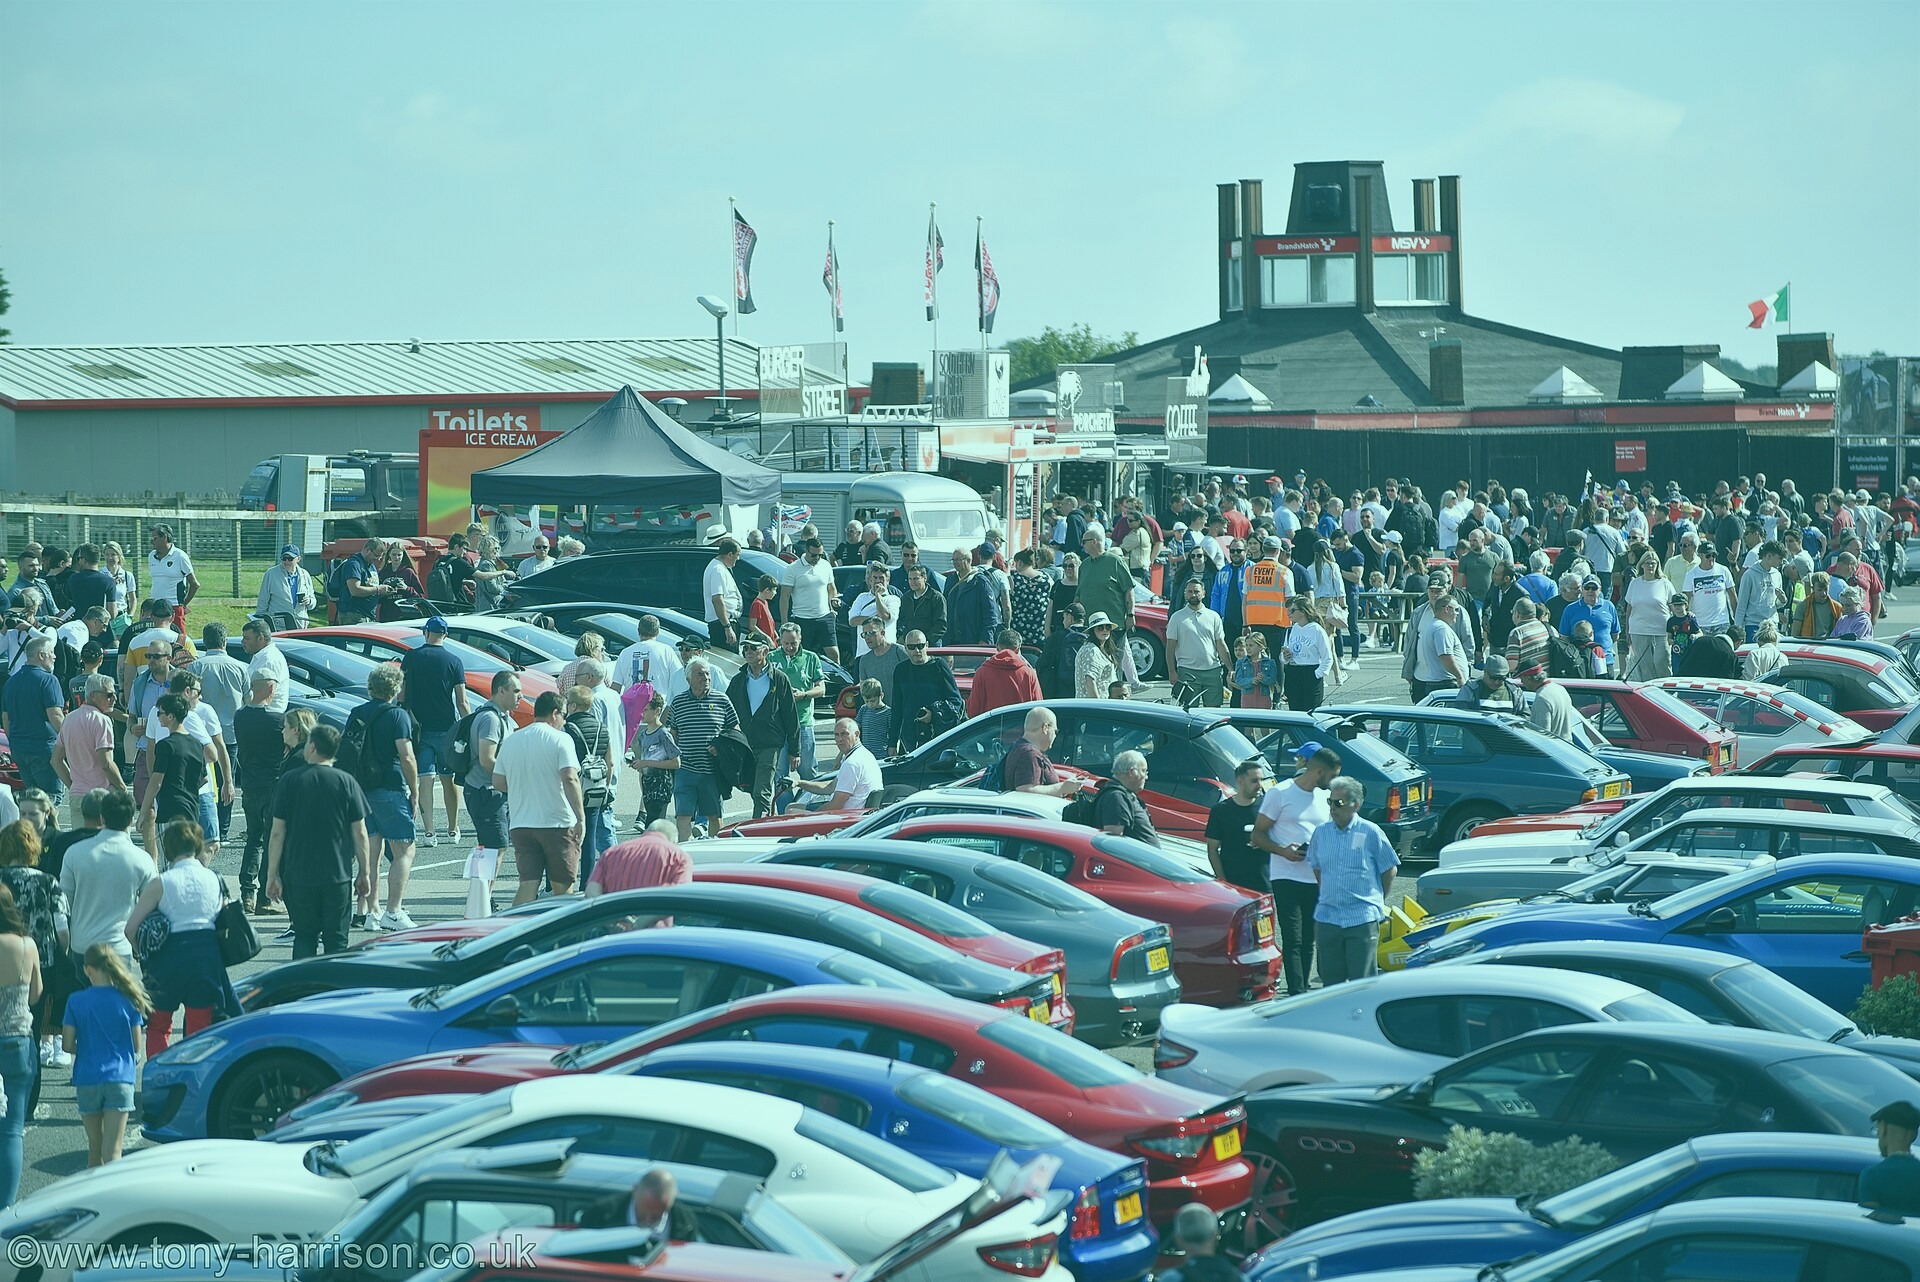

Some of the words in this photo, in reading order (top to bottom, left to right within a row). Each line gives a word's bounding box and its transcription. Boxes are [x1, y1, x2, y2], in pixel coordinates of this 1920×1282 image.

[1391, 237, 1418, 250] MSV
[760, 346, 804, 380] BURGER
[802, 384, 847, 418] STREET
[433, 409, 528, 431] Toilets
[1073, 412, 1116, 432] PORCHETTA
[1166, 404, 1198, 438] COFFEE
[465, 433, 487, 445] ICE
[491, 433, 538, 446] CREAM
[1253, 567, 1275, 576] EVENT
[1253, 576, 1272, 585] TEAM
[1785, 904, 1847, 912] university
